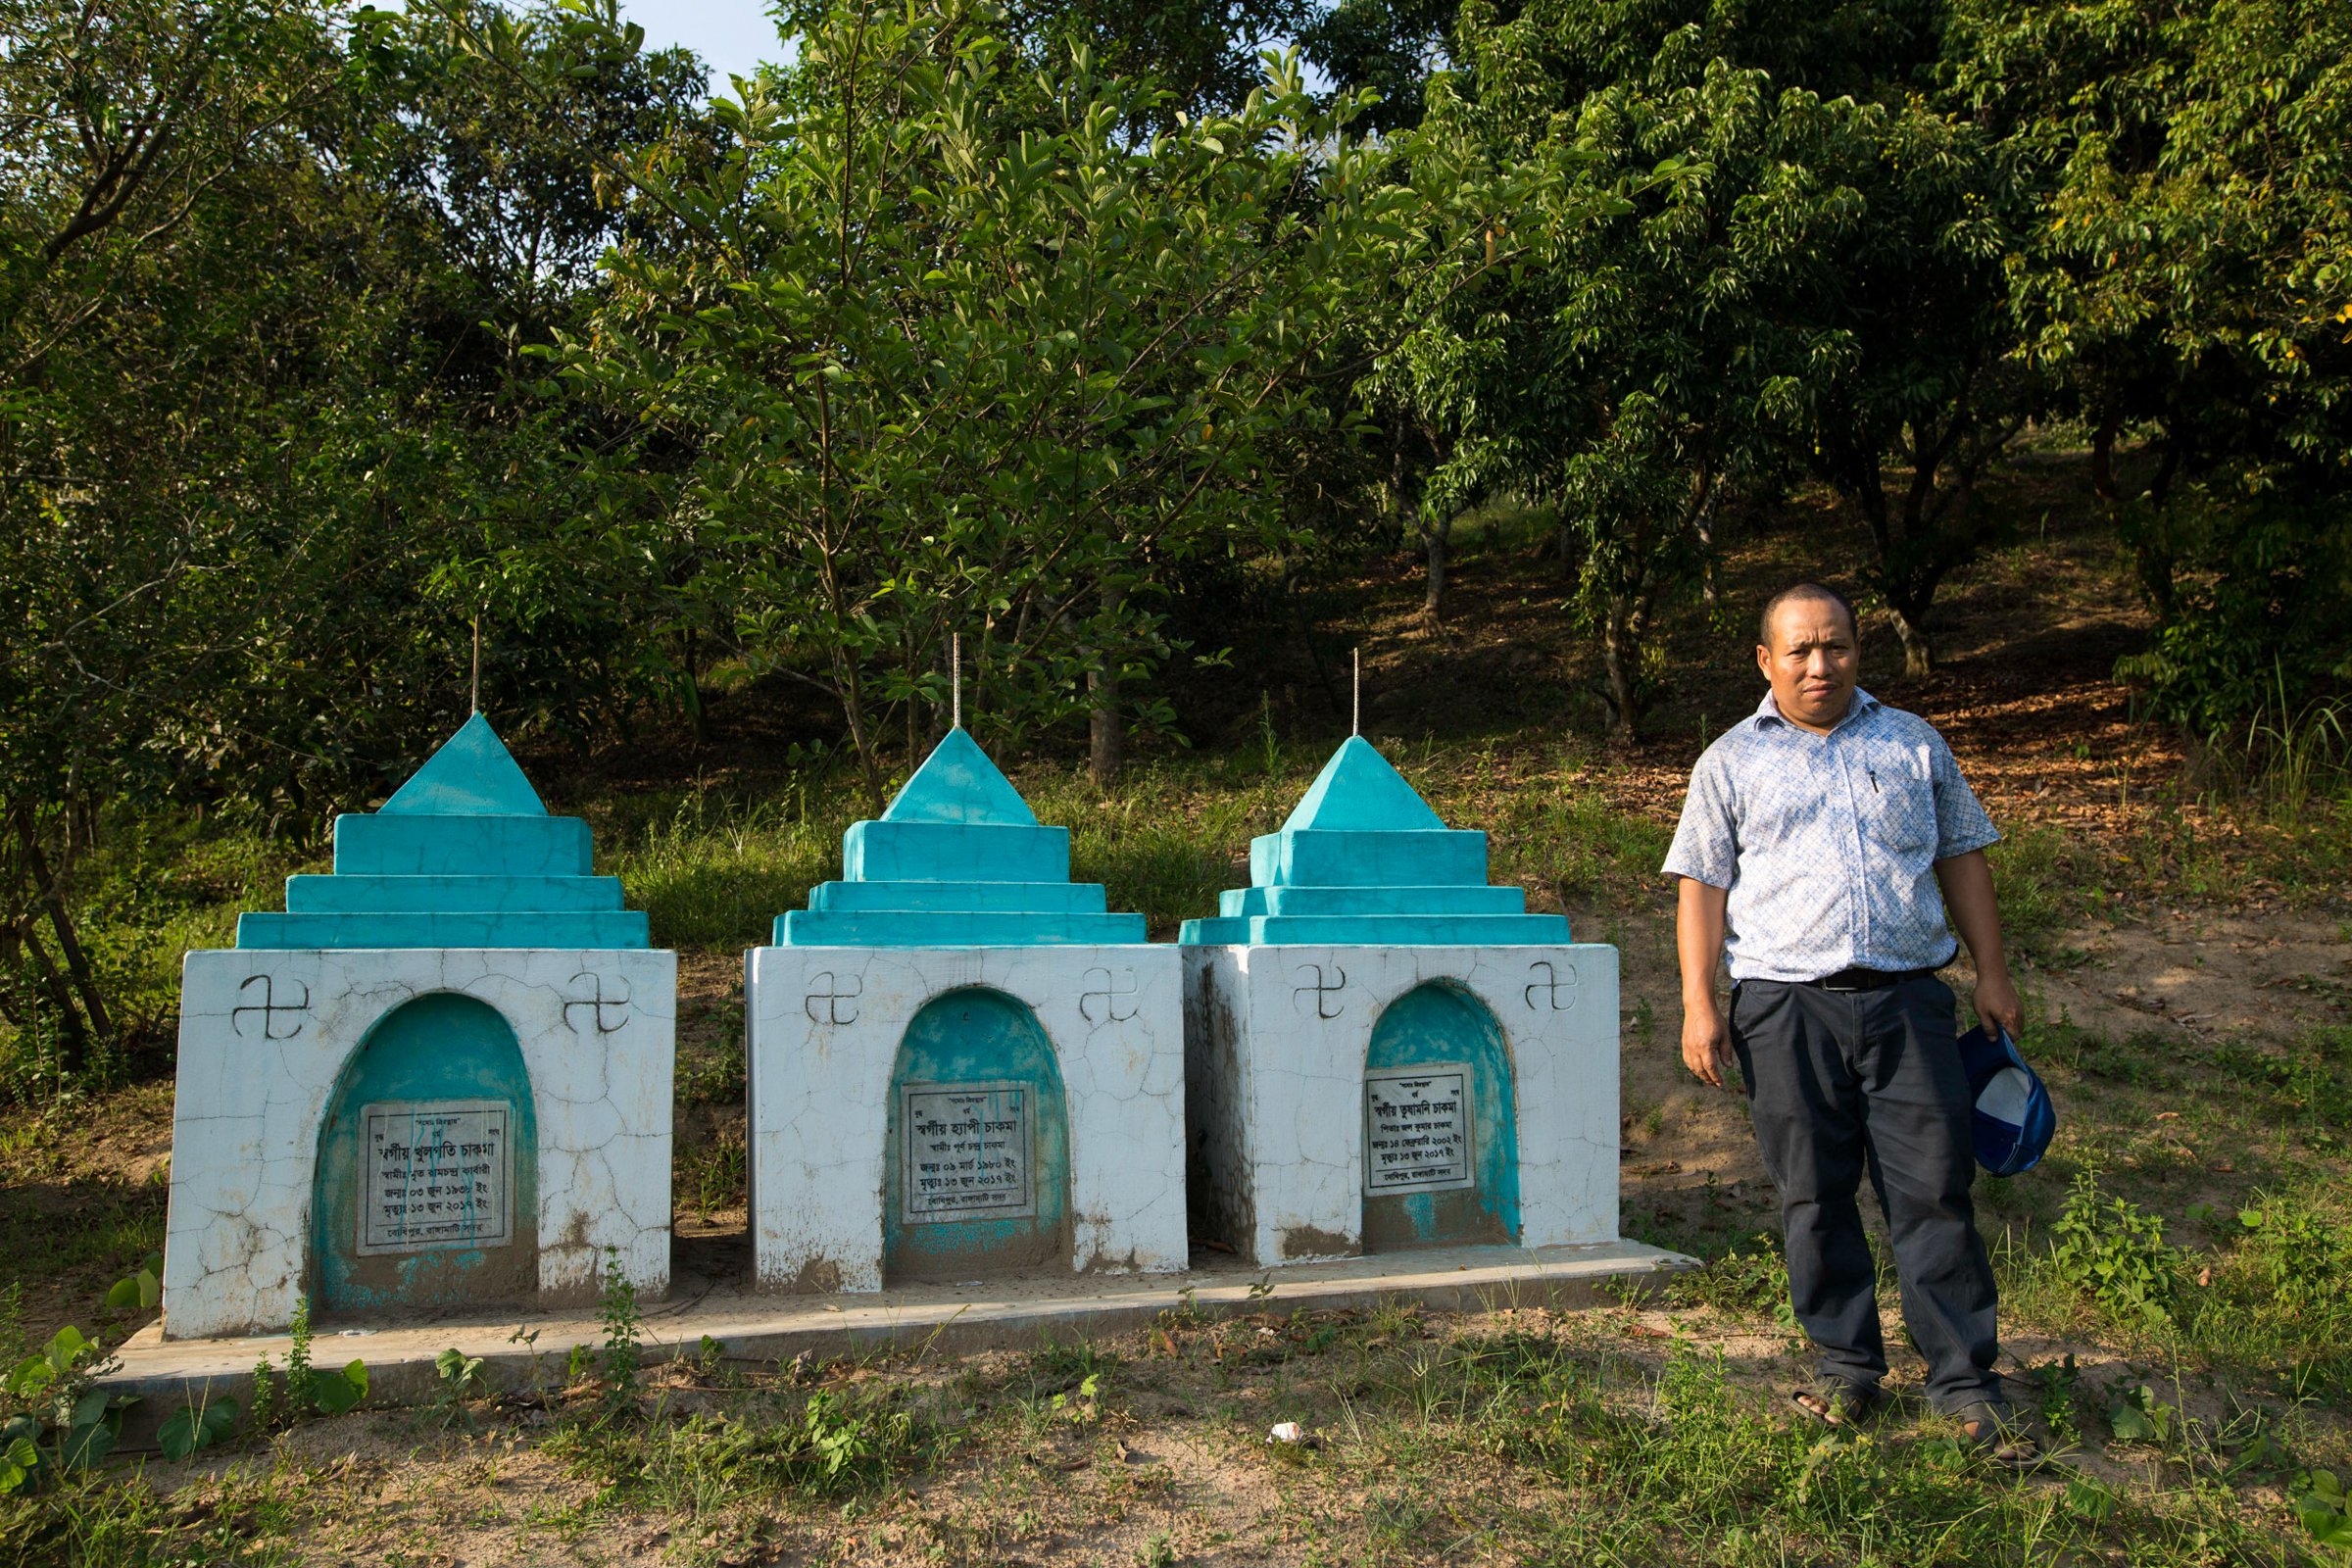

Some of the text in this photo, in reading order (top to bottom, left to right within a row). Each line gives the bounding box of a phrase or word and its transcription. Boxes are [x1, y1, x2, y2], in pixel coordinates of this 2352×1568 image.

[1433, 1101, 1456, 1114] চাকমা
[915, 1118, 1016, 1136] স্বর্গীয় হ্যাপী চাকমা
[1434, 1121, 1452, 1130] চাকমা
[1453, 1134, 1462, 1144] ইং
[461, 1143, 494, 1157] চাকমা
[1412, 1152, 1423, 1161] জুন
[1425, 1150, 1445, 1159] ২০১৭
[1446, 1147, 1454, 1157] ইং
[958, 1157, 975, 1171] মার্চ
[1004, 1157, 1016, 1169] ইং
[945, 1178, 957, 1187] ১৩
[960, 1177, 974, 1188] জুন
[978, 1175, 1002, 1186] ২০১৭
[411, 1188, 423, 1197] ০৩
[427, 1187, 442, 1199] জুন
[476, 1181, 488, 1194] ইং
[411, 1203, 423, 1212] ১৩
[427, 1202, 442, 1214] জুন
[446, 1200, 472, 1213] ২০১৭
[476, 1198, 488, 1209] ইং
